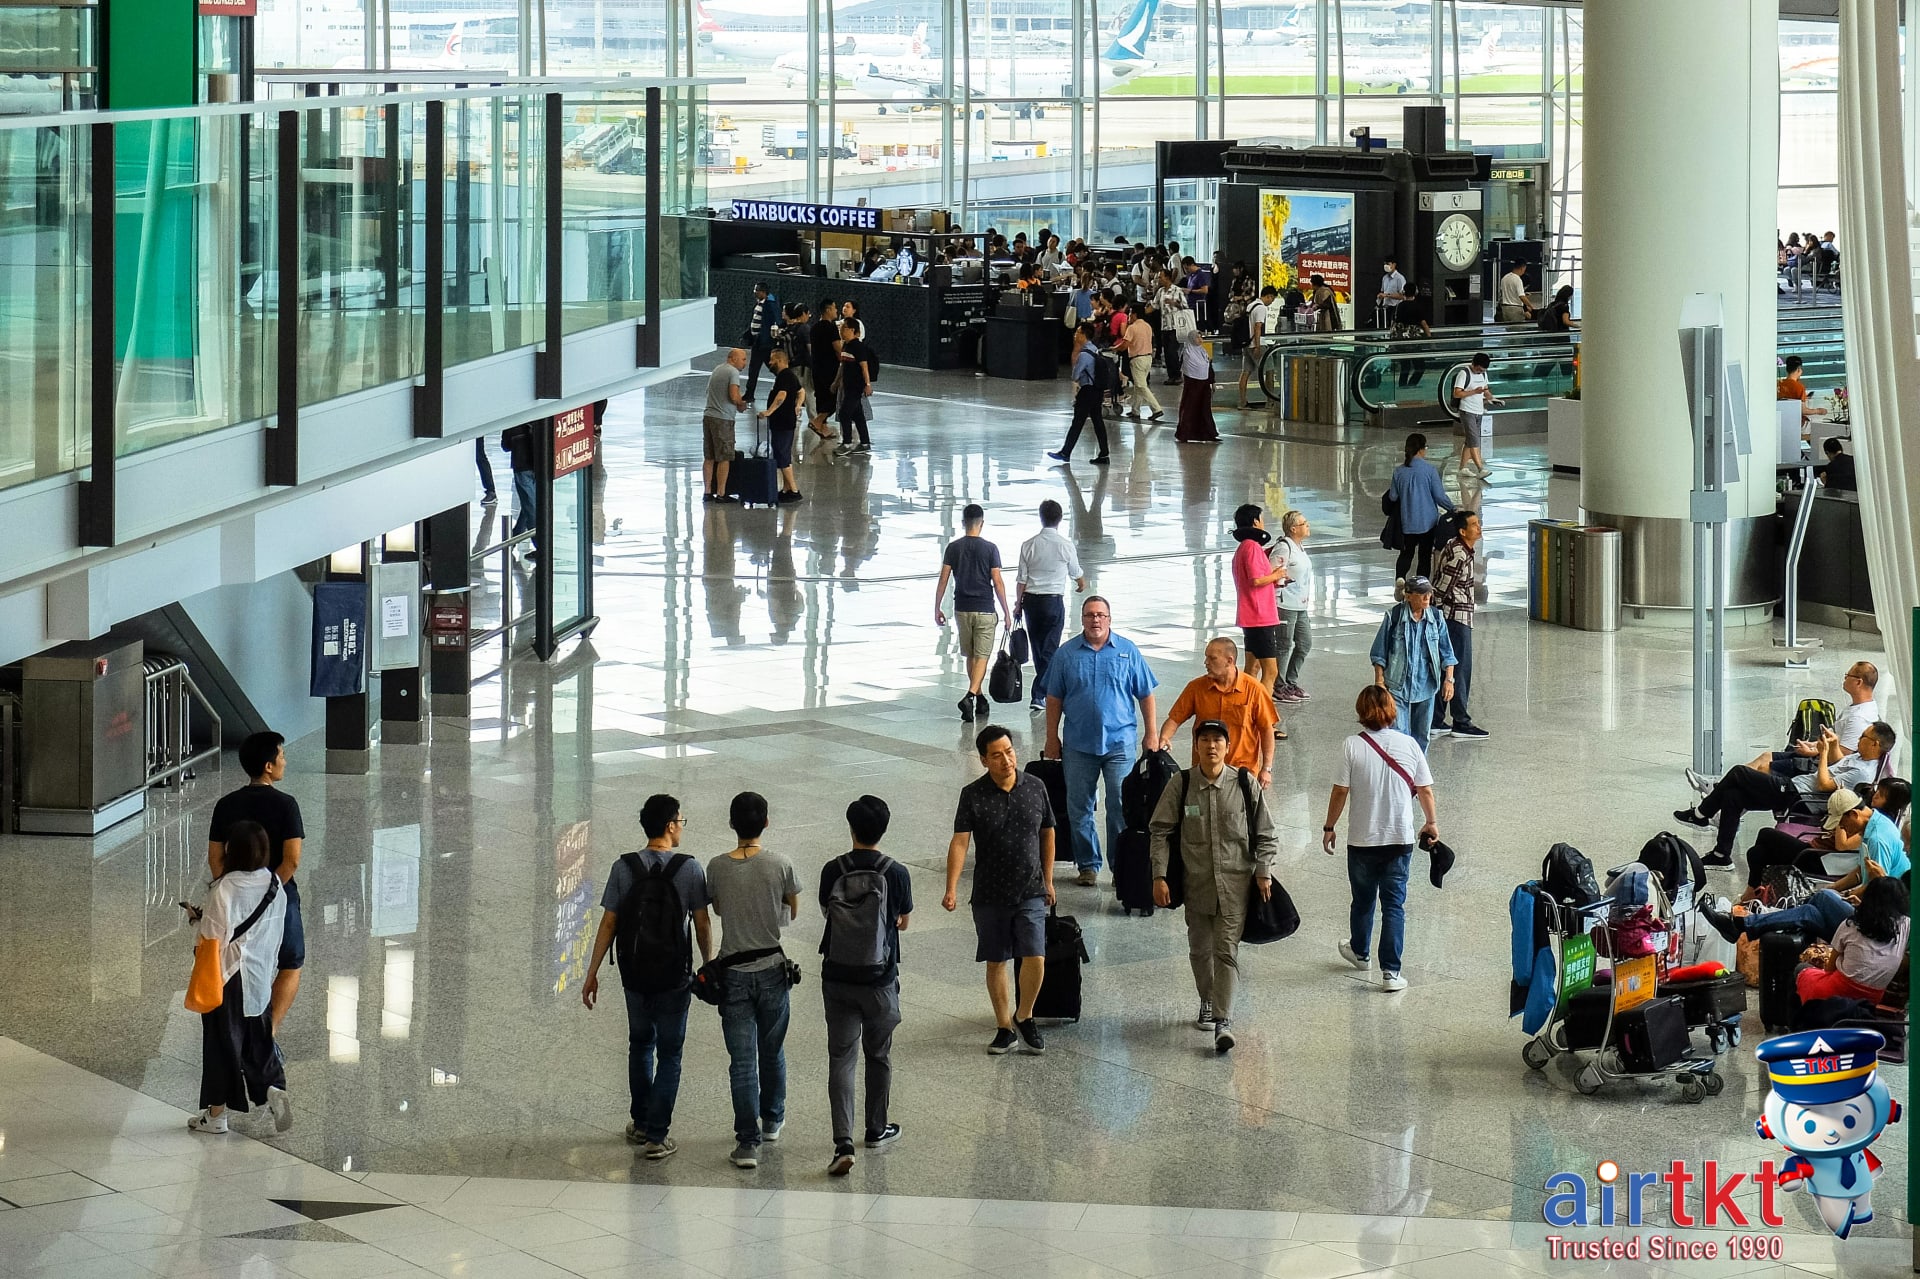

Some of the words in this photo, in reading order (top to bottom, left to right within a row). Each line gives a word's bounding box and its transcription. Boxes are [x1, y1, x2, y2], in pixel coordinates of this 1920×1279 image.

[1491, 170, 1506, 179] EXIT
[732, 202, 816, 224] STARBUCKS
[820, 208, 876, 228] COFFEE
[1326, 272, 1348, 280] University
